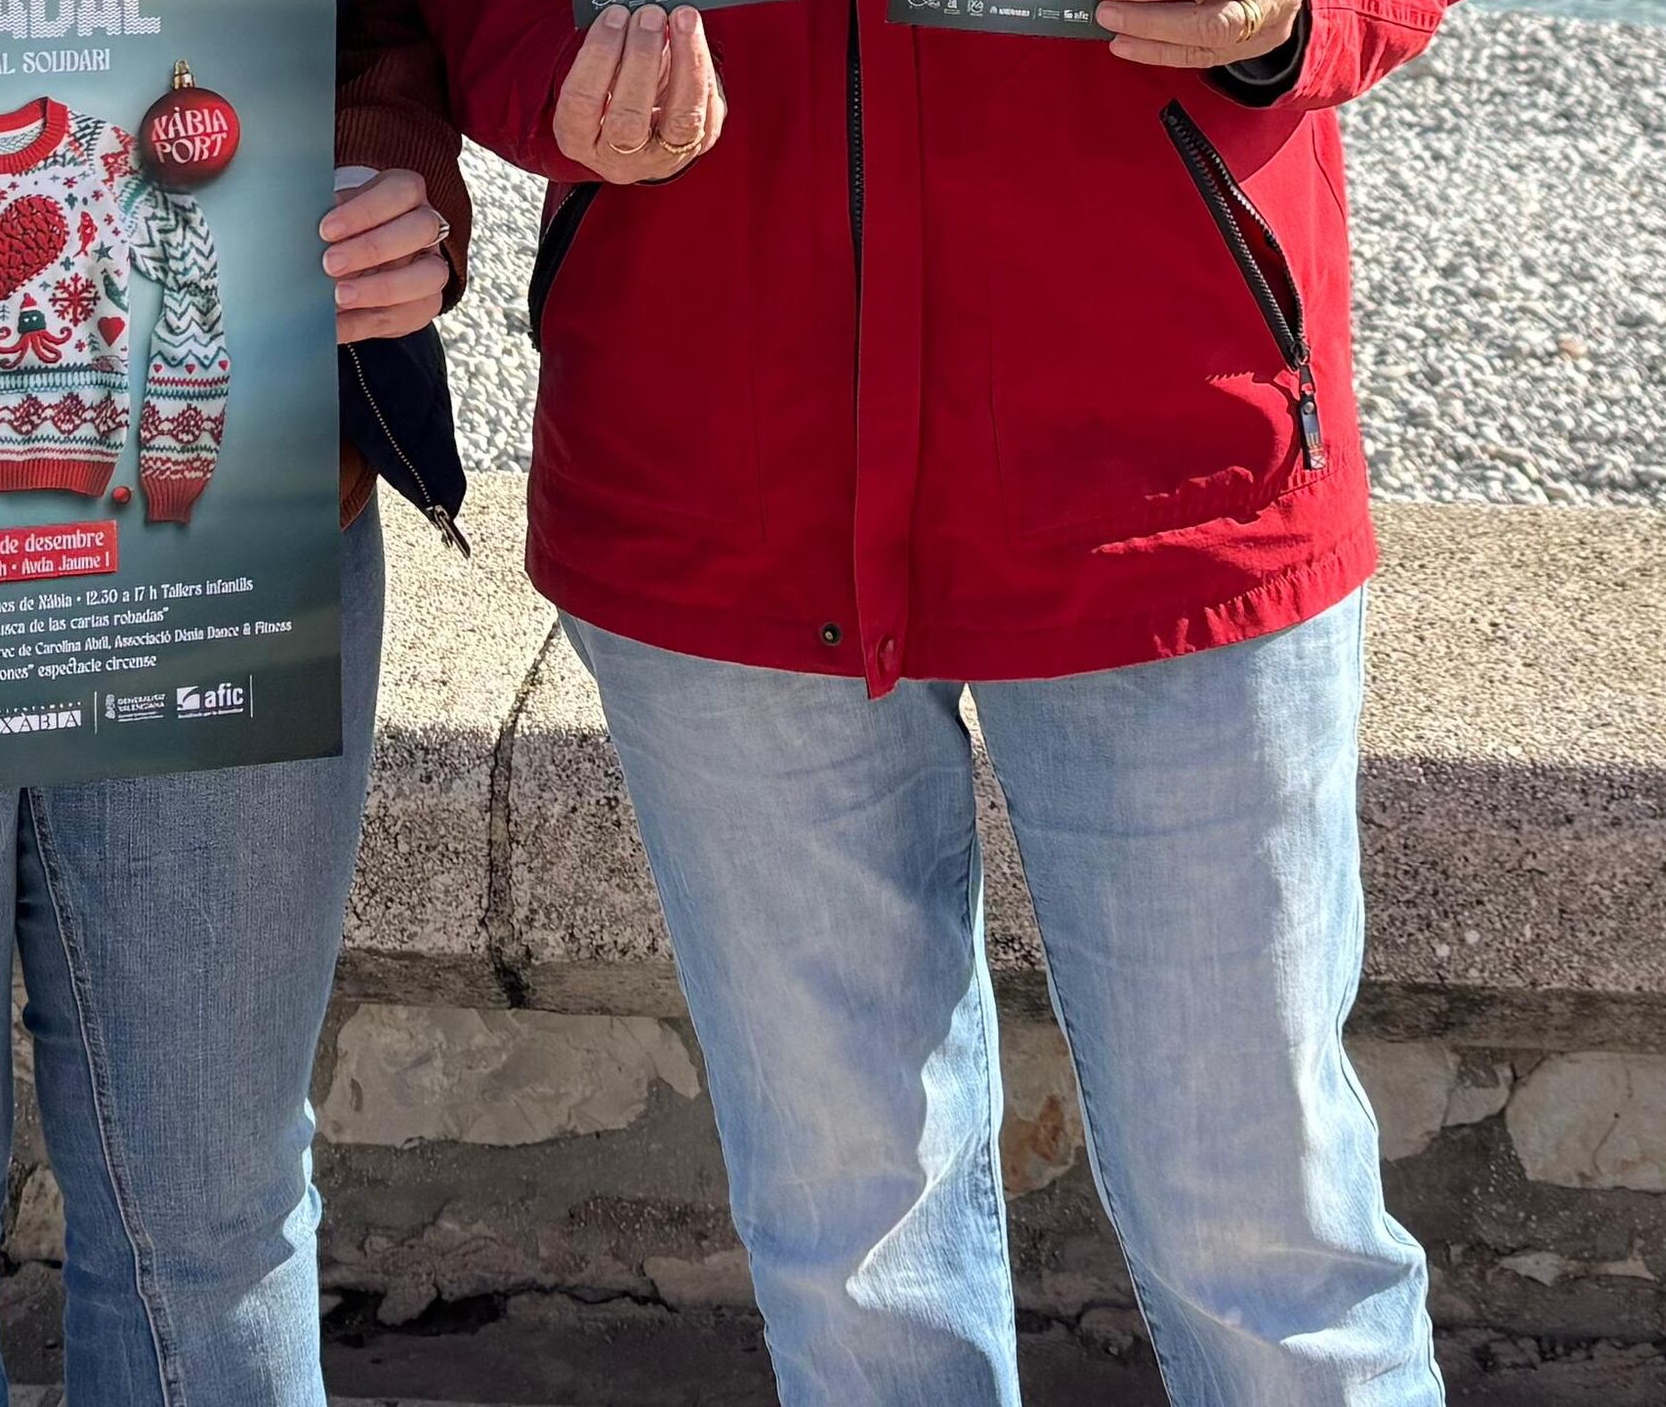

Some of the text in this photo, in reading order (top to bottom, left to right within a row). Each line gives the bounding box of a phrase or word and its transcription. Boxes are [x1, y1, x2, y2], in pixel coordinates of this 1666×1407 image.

[23, 48, 110, 74] SOLIDARI
[151, 106, 229, 142] XÀBIA
[154, 132, 228, 164] PORT
[0, 535, 18, 554] de
[25, 529, 105, 553] desembre
[21, 556, 54, 576] Avda
[58, 554, 101, 572] Jaume
[19, 596, 35, 612] de
[38, 593, 72, 611] Xàbia
[85, 588, 118, 606] 12.30
[122, 590, 130, 603] a
[134, 586, 145, 602] 17
[149, 585, 157, 600] h
[161, 582, 203, 599] Tallers
[206, 577, 254, 595] infantils
[29, 617, 45, 634] de
[48, 616, 67, 632] las
[70, 613, 110, 630] cartas
[18, 643, 32, 657] de
[35, 640, 82, 656] Carolina
[114, 630, 172, 649] Associació
[207, 625, 240, 640] Dance
[254, 620, 292, 635] Fitness
[37, 656, 102, 680] espectacle
[105, 655, 158, 672] circense
[204, 682, 244, 709] afic
